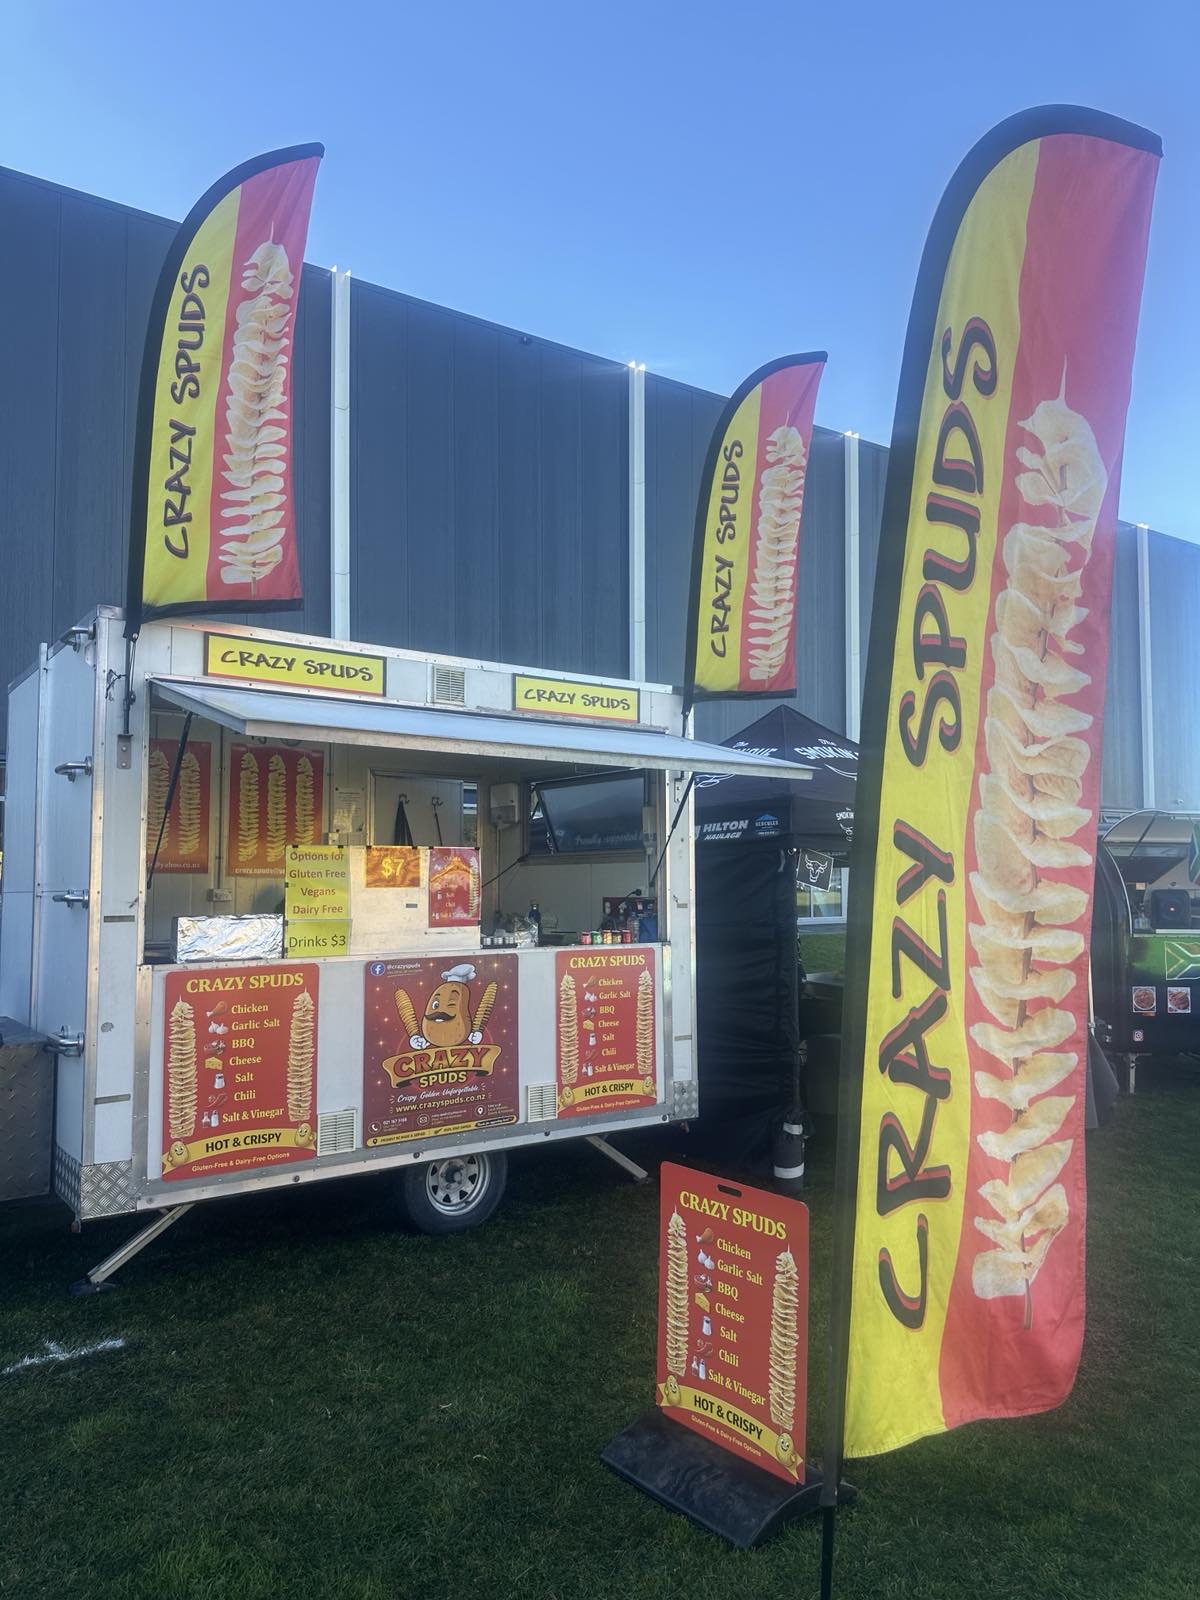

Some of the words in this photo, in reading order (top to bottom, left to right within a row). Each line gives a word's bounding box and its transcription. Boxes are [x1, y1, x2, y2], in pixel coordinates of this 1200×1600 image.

[171, 263, 210, 405] SPUDS
[163, 418, 196, 560] CRAZY
[716, 439, 743, 545] SPUDS
[897, 313, 999, 770] SPUDS
[711, 554, 734, 658] CRAZY
[221, 650, 296, 671] CRAZY
[304, 659, 374, 682] SPUDS
[524, 689, 576, 705] CRAZY
[581, 694, 631, 711] SPUDS
[703, 820, 749, 832] HILTON
[704, 832, 743, 840] HAULAGE
[290, 851, 328, 862] Options
[331, 851, 345, 861] for
[289, 869, 323, 878] Gluten
[326, 869, 346, 878] Free
[381, 856, 404, 878] $7
[300, 887, 336, 898] Vegans
[292, 905, 319, 915] Dairy
[322, 905, 343, 914] Free
[289, 935, 327, 948] Drinks
[331, 935, 346, 947] $3
[569, 956, 608, 968] CRAZY
[609, 954, 645, 967] SPUDS
[186, 976, 246, 993] CRAZY
[249, 972, 304, 989] SPUDS
[598, 978, 623, 986] Chicken
[599, 991, 618, 999] Garlic
[619, 990, 631, 998] Salt
[231, 1004, 269, 1014] Chicken
[599, 1006, 615, 1014] BBQ
[231, 1021, 260, 1031] Garlic
[263, 1018, 280, 1028] Salt
[598, 1019, 620, 1028] Cheese
[232, 1037, 255, 1049] BBQ
[602, 1033, 615, 1041] Salt
[229, 1056, 262, 1066] Cheese
[601, 1048, 617, 1057] Chili
[393, 1047, 490, 1078] CRAZY
[594, 1064, 607, 1073] Salt
[607, 1064, 613, 1072] &
[612, 1062, 635, 1072] Vinegar
[235, 1072, 254, 1083] Salt
[419, 1071, 467, 1088] SPUDS
[875, 816, 955, 1334] CRAZY
[234, 1090, 256, 1101] Chili
[397, 1094, 417, 1103] Crispy
[420, 1091, 440, 1100] Golden
[442, 1085, 479, 1096] Unforgettable
[584, 1086, 600, 1096] HOT
[602, 1085, 608, 1093] &
[609, 1082, 634, 1093] CRISPY
[395, 1093, 486, 1113] www.crazyspuds.co.nz
[222, 1112, 240, 1123] Salt
[241, 1111, 249, 1120] &
[250, 1107, 284, 1119] Vinegar
[205, 1139, 230, 1153] HOT
[232, 1137, 241, 1147] &
[243, 1132, 282, 1146] CRISPY
[191, 1161, 228, 1172] Gluten-Free
[235, 1156, 266, 1166] Dairy-Free
[267, 1152, 290, 1160] Options
[679, 1190, 731, 1221] CRAZY
[732, 1207, 787, 1240] SPUDS
[716, 1238, 752, 1260] Chicken
[717, 1259, 743, 1278] Garlic
[746, 1270, 763, 1286] Salt
[717, 1281, 739, 1302] BBQ
[715, 1302, 745, 1324] Cheese
[720, 1326, 737, 1343] Salt
[718, 1348, 739, 1367] Chili
[708, 1368, 724, 1386] Salt
[725, 1377, 732, 1390] &
[733, 1379, 766, 1405] Vinegar
[694, 1394, 714, 1413] HOT
[716, 1404, 724, 1419] &
[726, 1410, 763, 1440] CRISPY
